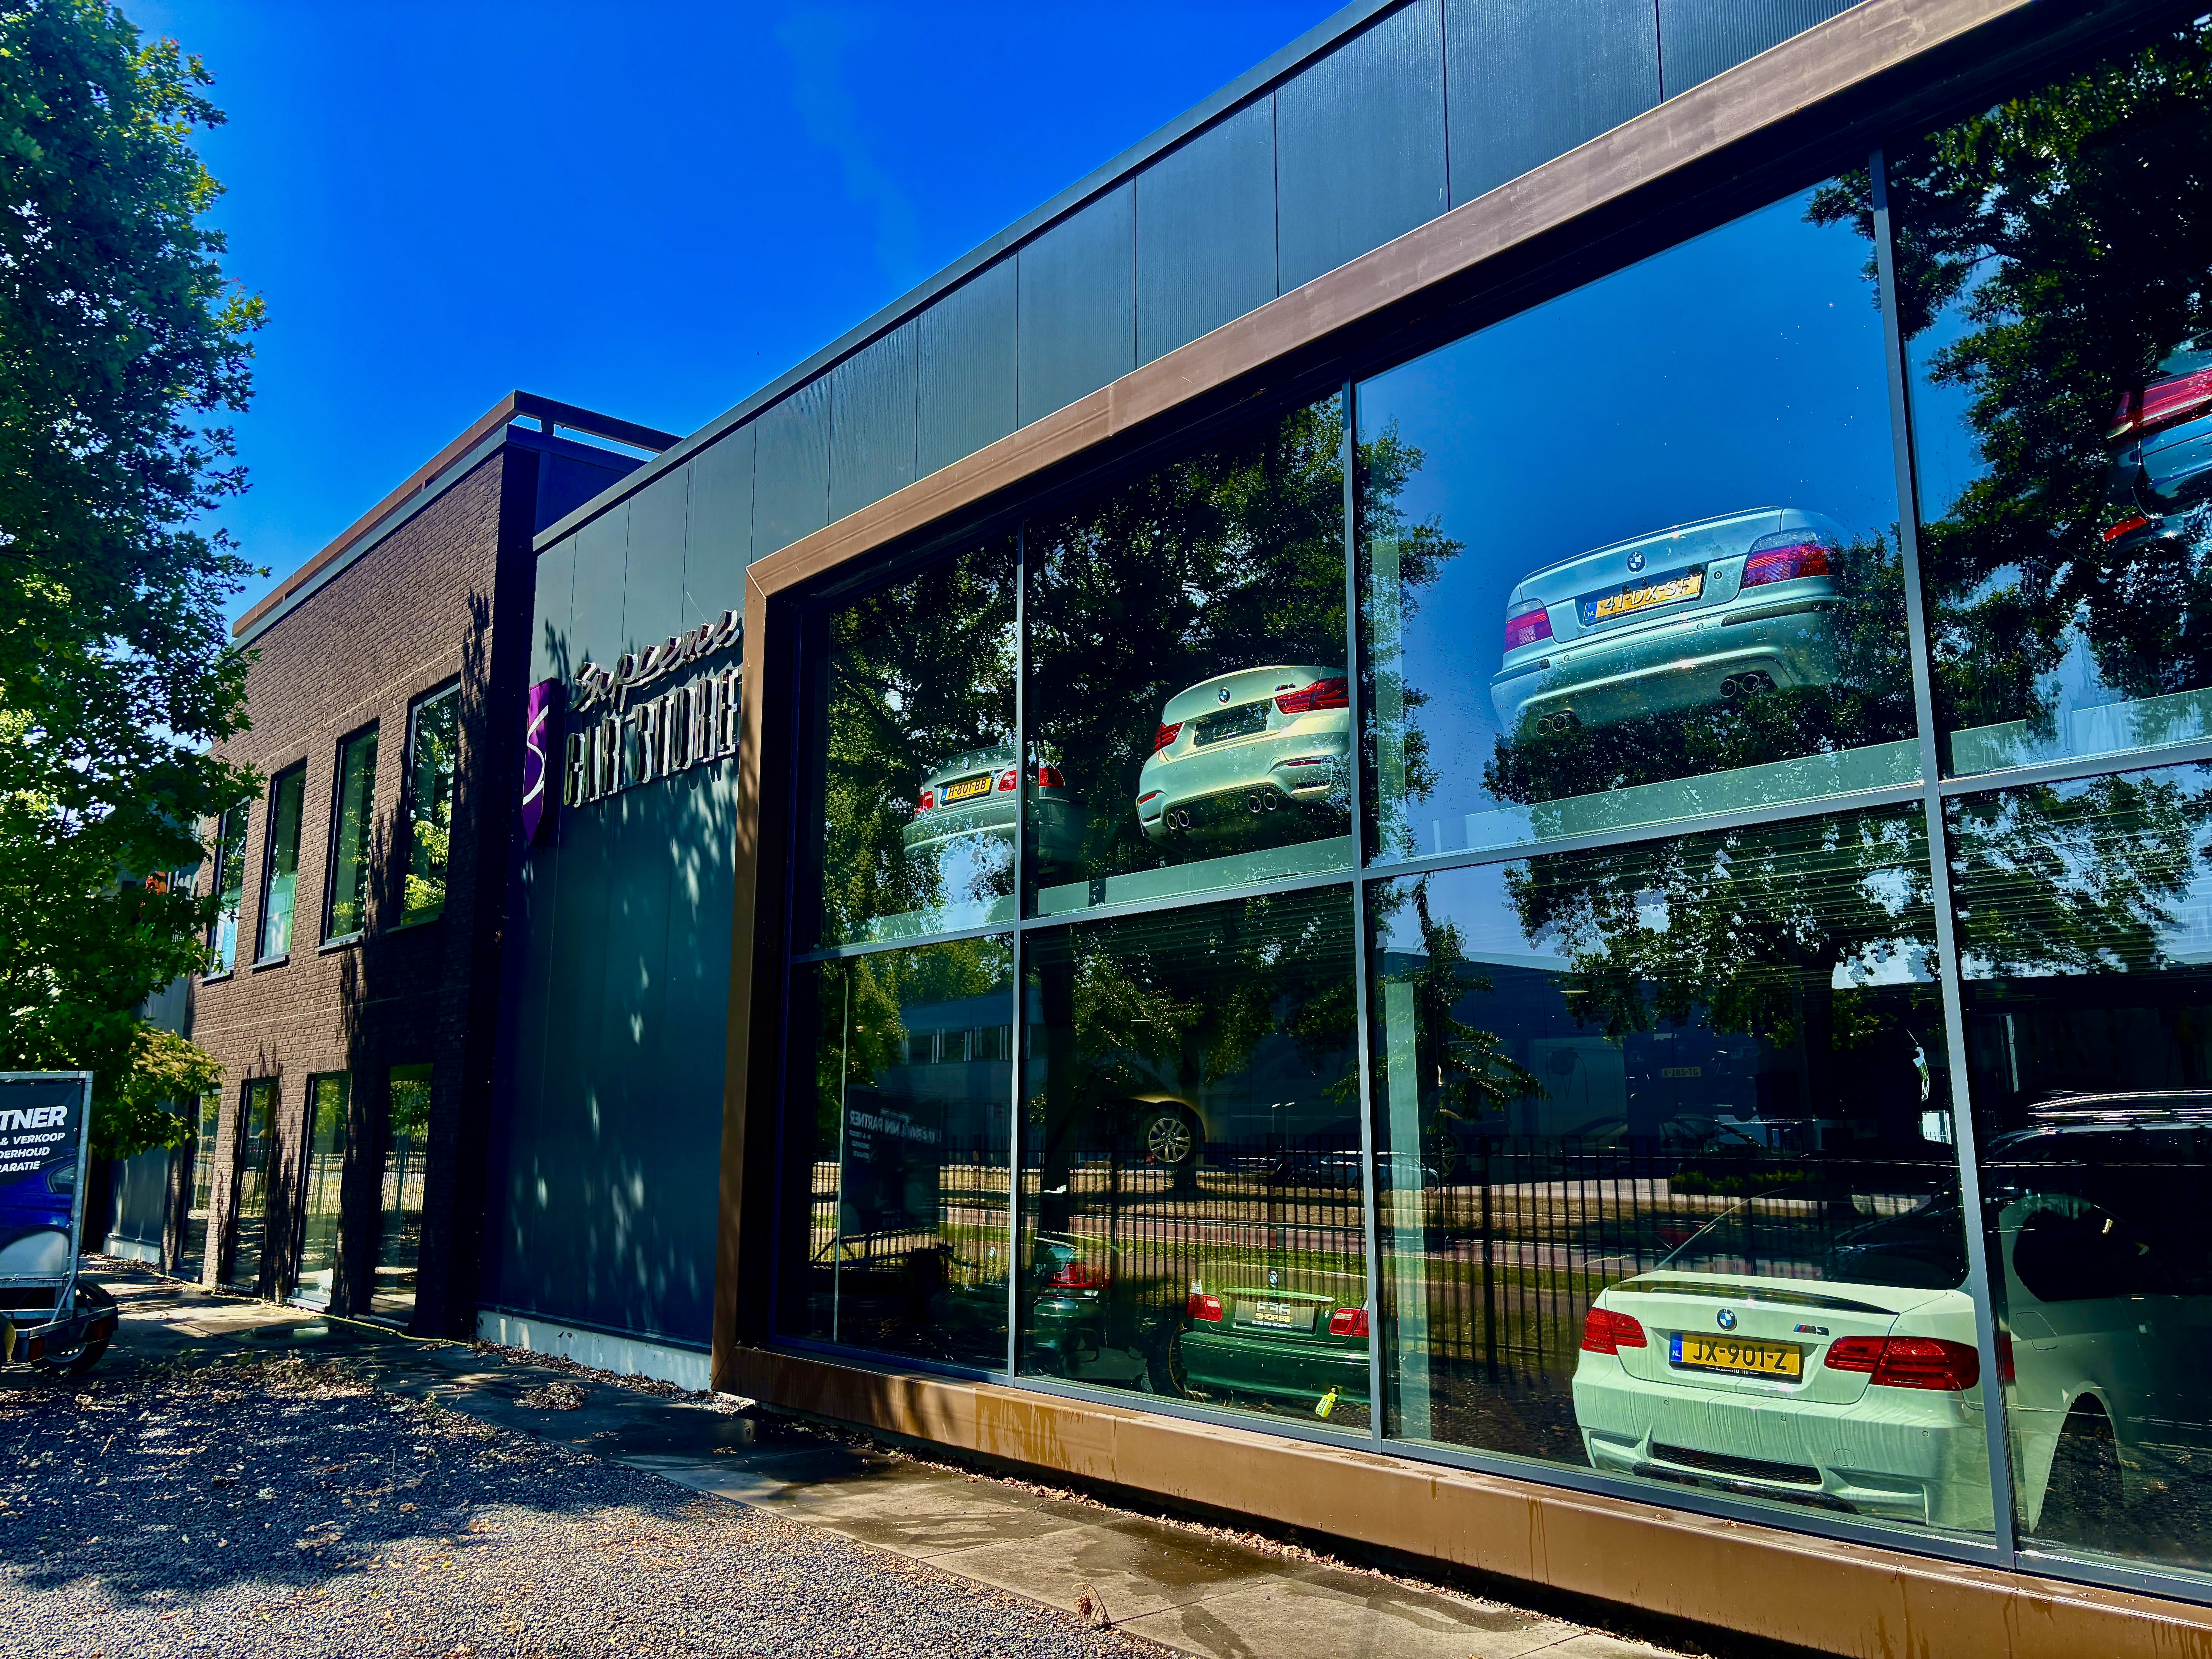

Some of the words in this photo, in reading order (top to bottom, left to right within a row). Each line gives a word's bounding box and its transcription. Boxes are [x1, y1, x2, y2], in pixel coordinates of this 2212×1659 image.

[1604, 577, 1691, 611] 41-DX-SF
[632, 668, 739, 784] STORE
[13, 1132, 65, 1145] VERKOOP
[0, 1161, 40, 1172] ARATIE
[1257, 1301, 1290, 1315] E36
[1693, 1340, 1787, 1370] JX-901-Z
